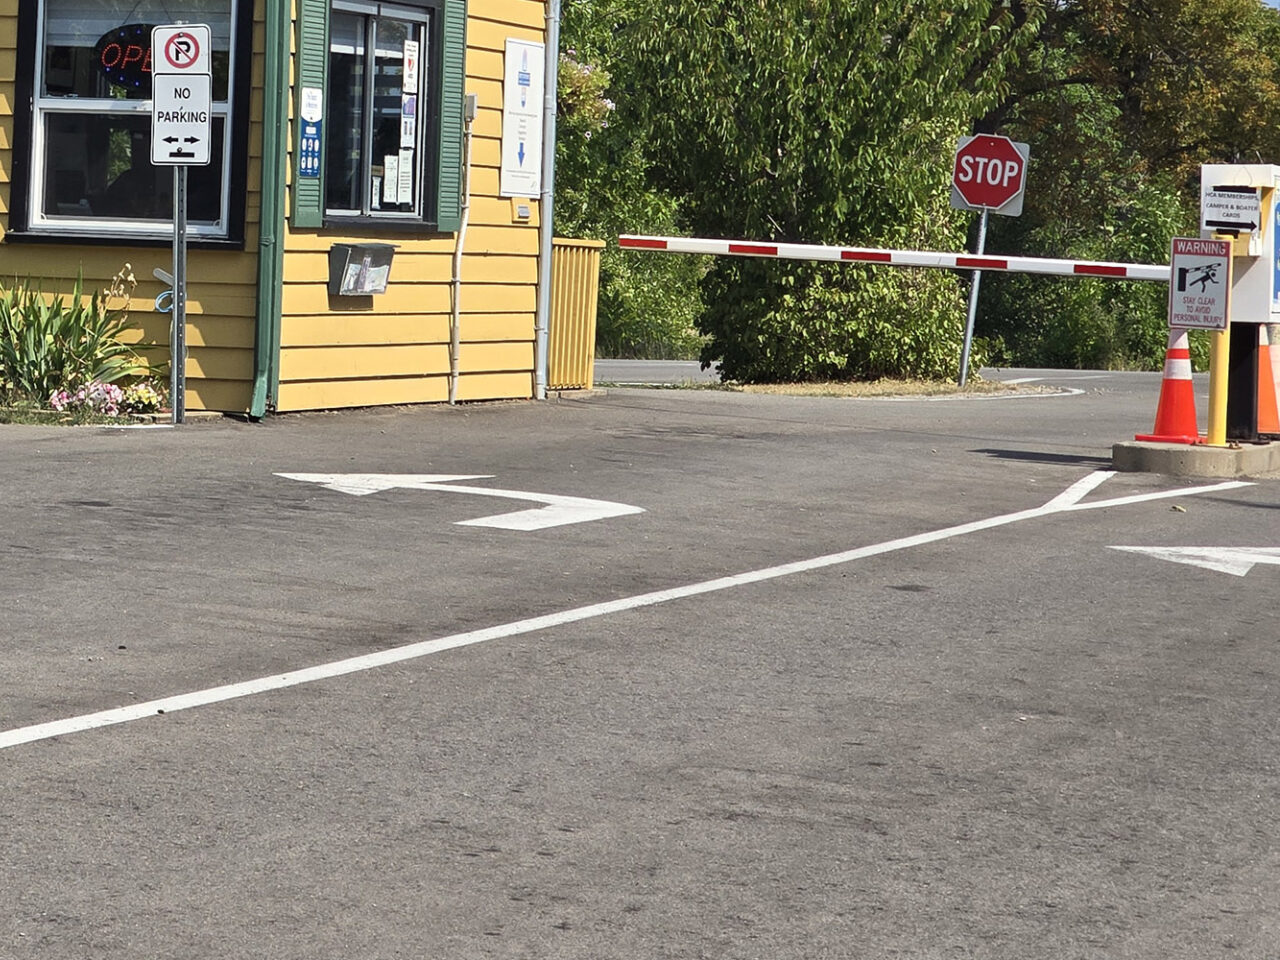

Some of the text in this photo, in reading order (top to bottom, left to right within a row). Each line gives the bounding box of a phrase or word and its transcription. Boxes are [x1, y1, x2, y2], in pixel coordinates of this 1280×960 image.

[102, 43, 152, 71] OPE
[174, 87, 191, 99] NO
[157, 111, 207, 123] PARKING
[958, 155, 1019, 187] STOP
[1177, 241, 1226, 255] WARNING
[1182, 296, 1216, 306] STAY CLEAR
[1186, 305, 1211, 314] TO AVOID
[1173, 313, 1224, 324] PERSONAL INJURY
